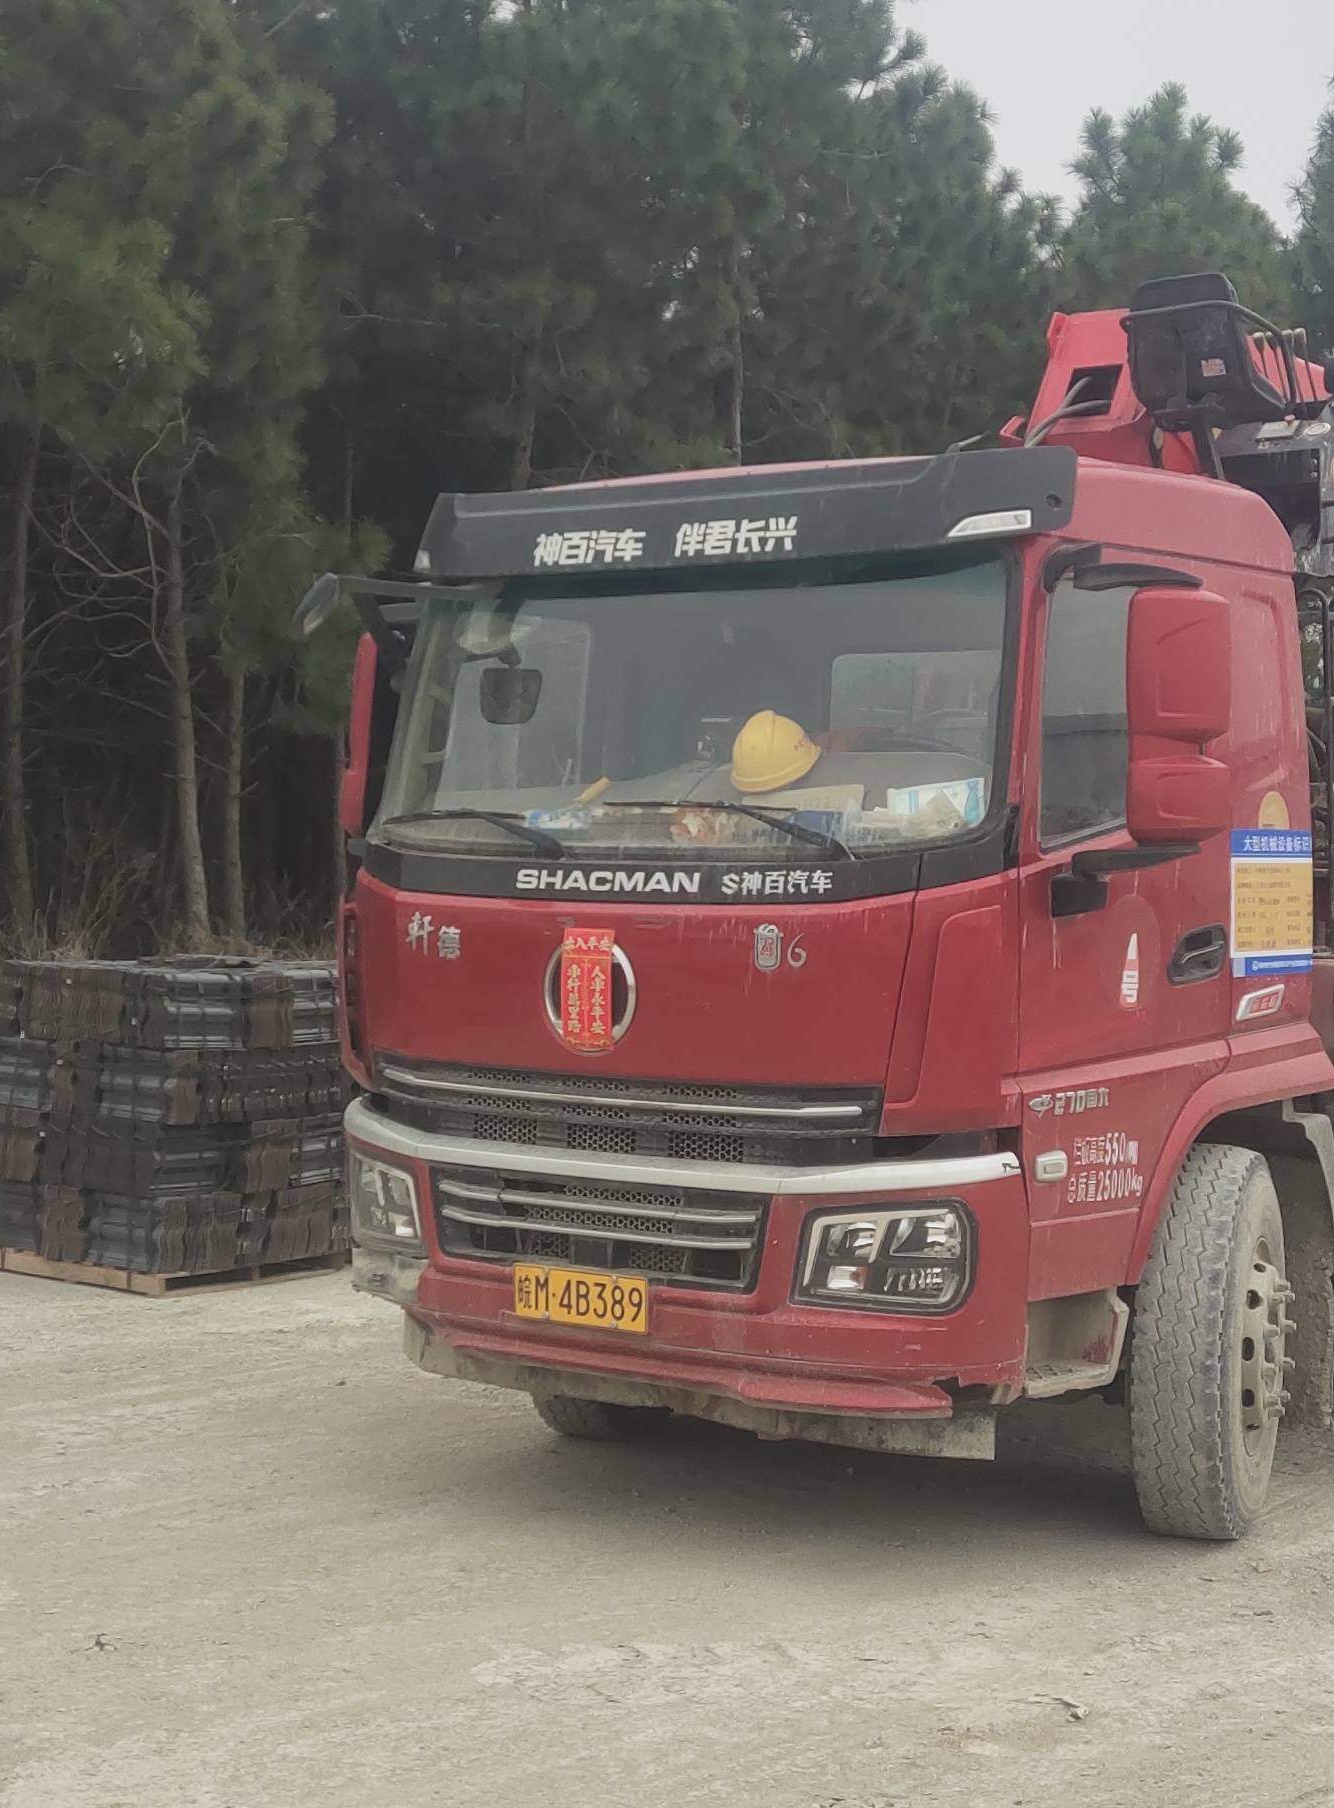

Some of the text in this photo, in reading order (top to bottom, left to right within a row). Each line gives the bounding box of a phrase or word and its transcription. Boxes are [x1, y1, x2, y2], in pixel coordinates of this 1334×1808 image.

[534, 516, 798, 567] 神百汽车 伴君长兴
[1243, 835, 1312, 852] 大型机械设备标识
[516, 869, 700, 893] SHACMAN
